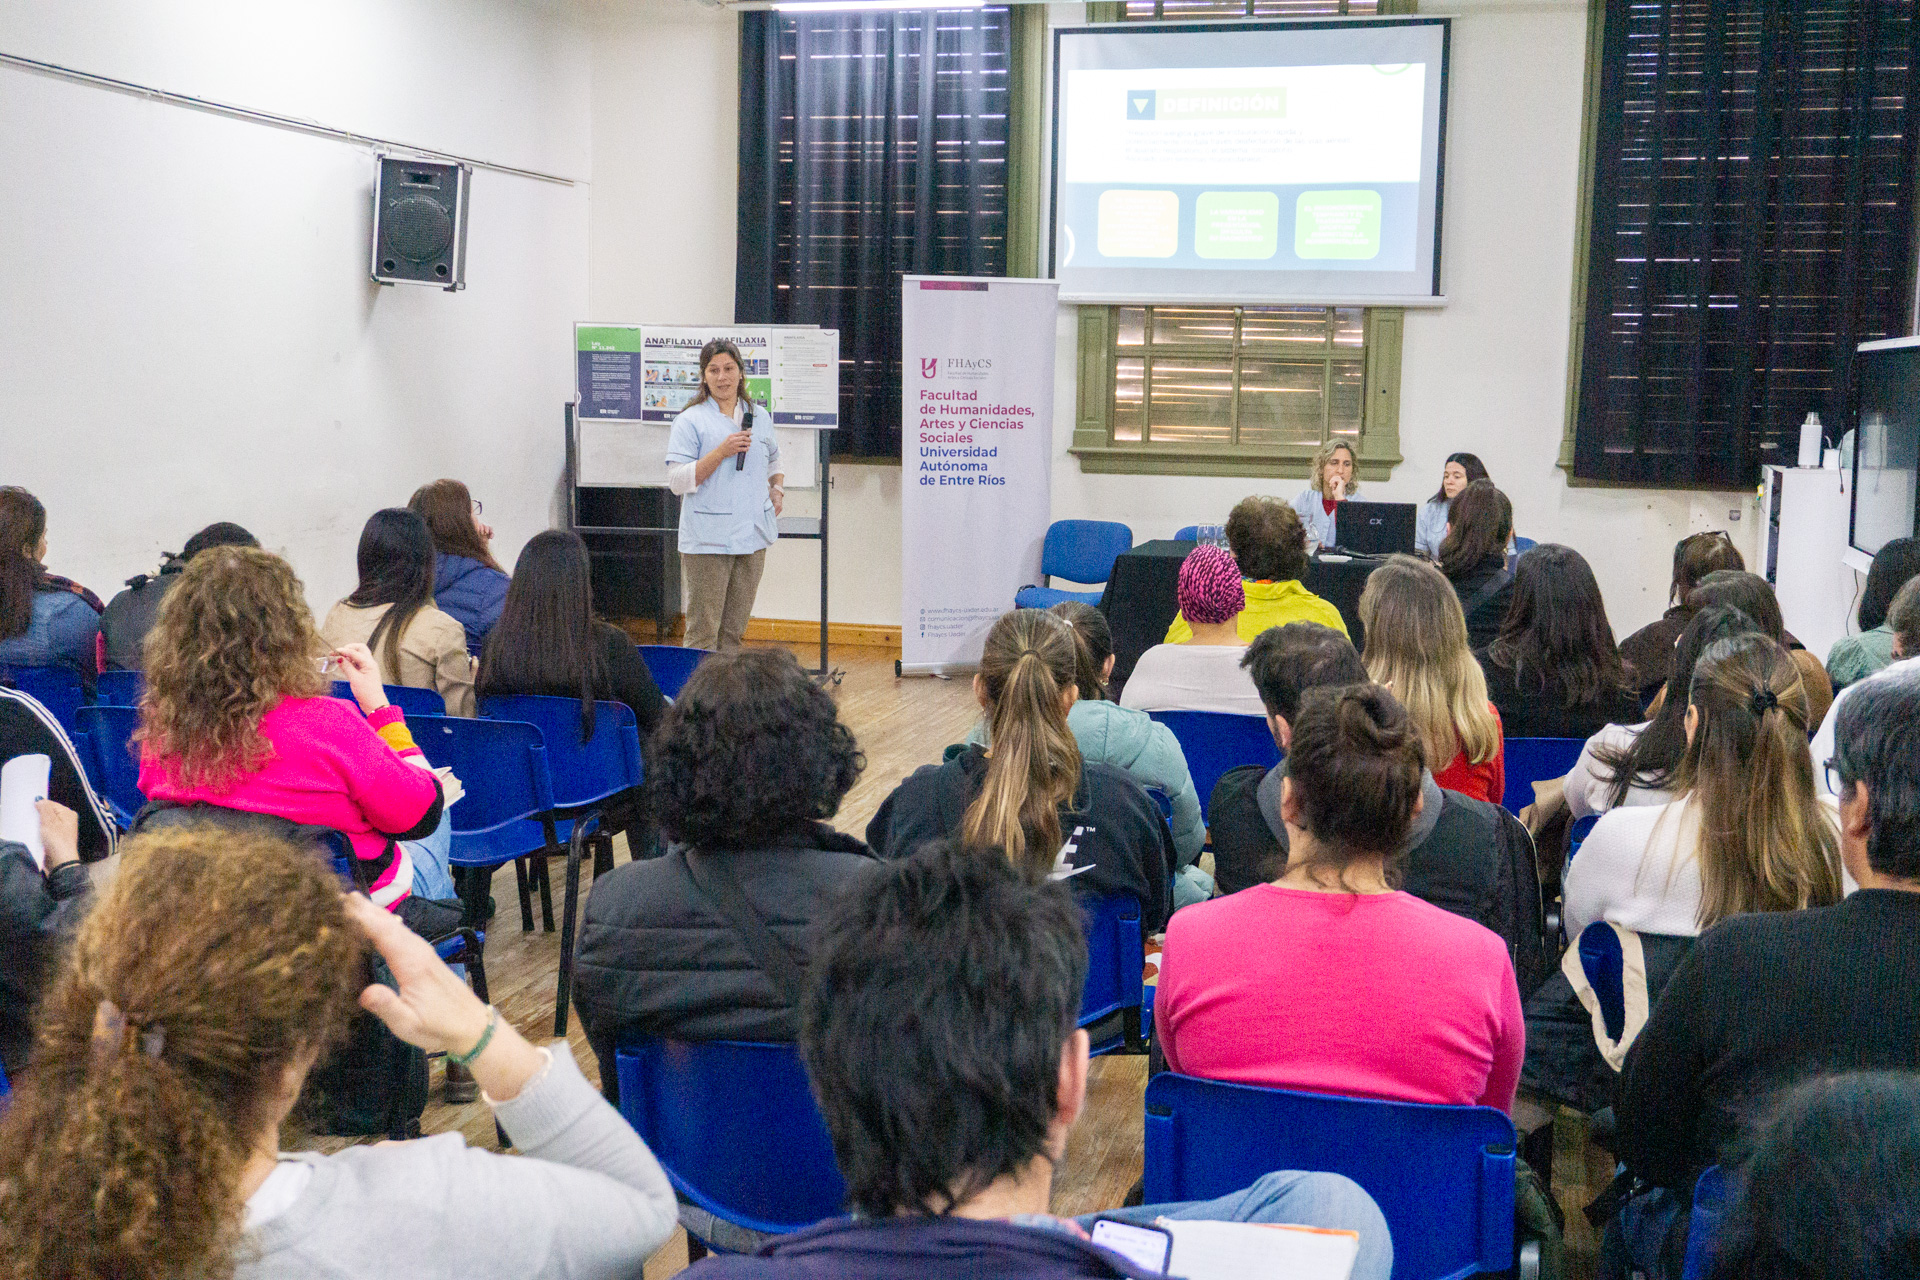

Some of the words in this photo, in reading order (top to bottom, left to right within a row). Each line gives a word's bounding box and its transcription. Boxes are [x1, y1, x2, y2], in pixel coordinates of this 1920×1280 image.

[1164, 93, 1279, 112] DEFINICIÓN
[645, 337, 703, 346] ANAFILAXIA
[947, 358, 992, 370] FHAyCS
[920, 389, 978, 401] Facultad
[920, 403, 936, 415] de
[940, 403, 1035, 417] Humanidades,
[920, 418, 955, 429] Artes
[958, 420, 966, 432] y
[969, 418, 1024, 430] Ciencias
[920, 432, 973, 443] Sociales
[920, 446, 998, 458] Universidad
[920, 460, 988, 472] Autónoma
[920, 474, 936, 486] de
[940, 474, 975, 486] Entre
[978, 474, 1006, 486] Ríos
